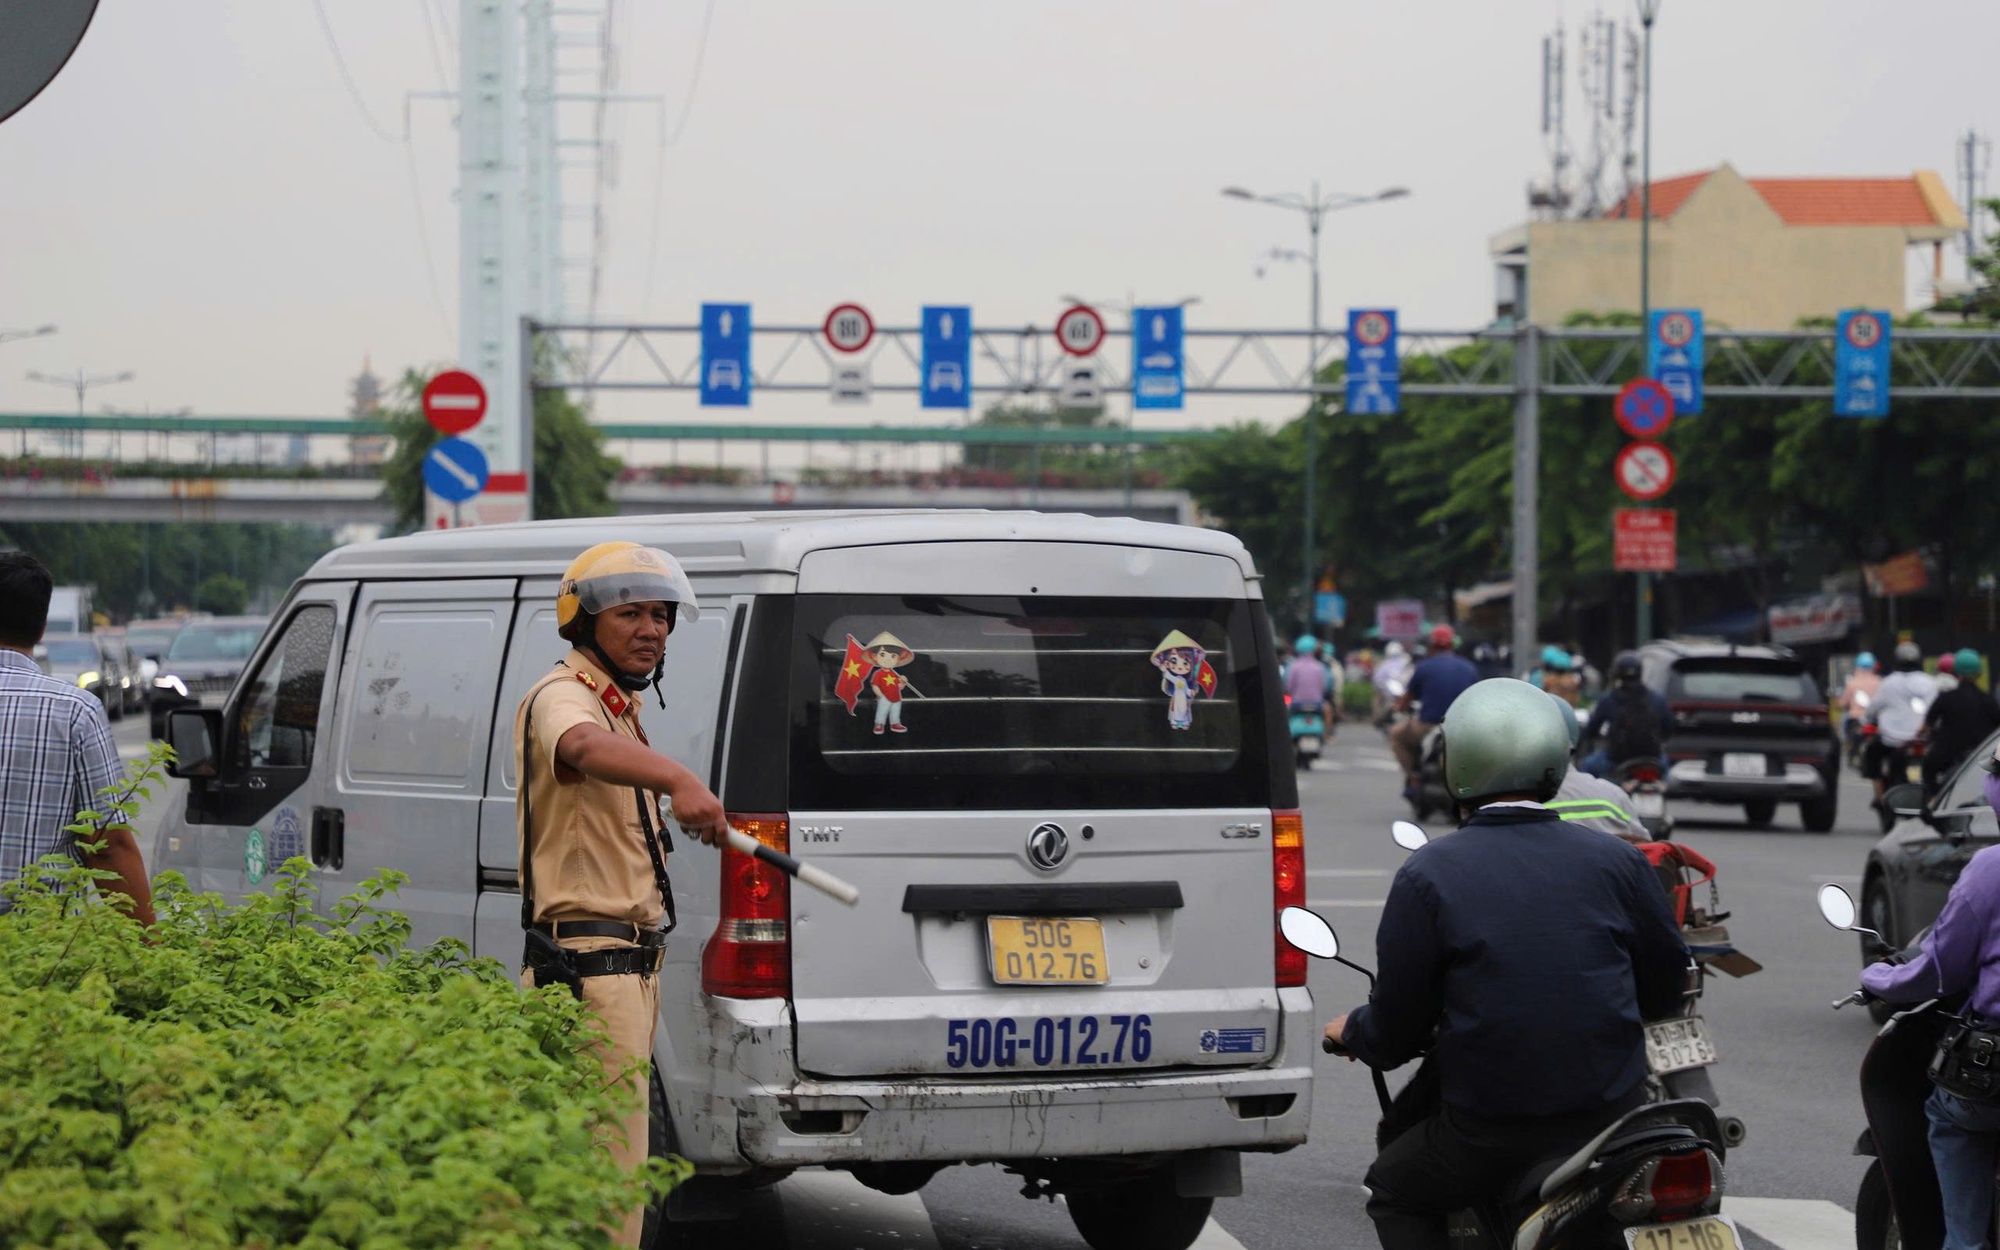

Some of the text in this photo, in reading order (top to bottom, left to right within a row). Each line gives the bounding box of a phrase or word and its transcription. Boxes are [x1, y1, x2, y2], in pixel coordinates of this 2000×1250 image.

[799, 826, 844, 842] TMT
[1220, 823, 1262, 839] C35
[1022, 921, 1072, 948] 50G
[1006, 952, 1097, 979] 012.76
[946, 1014, 1152, 1068] 50G-012.76
